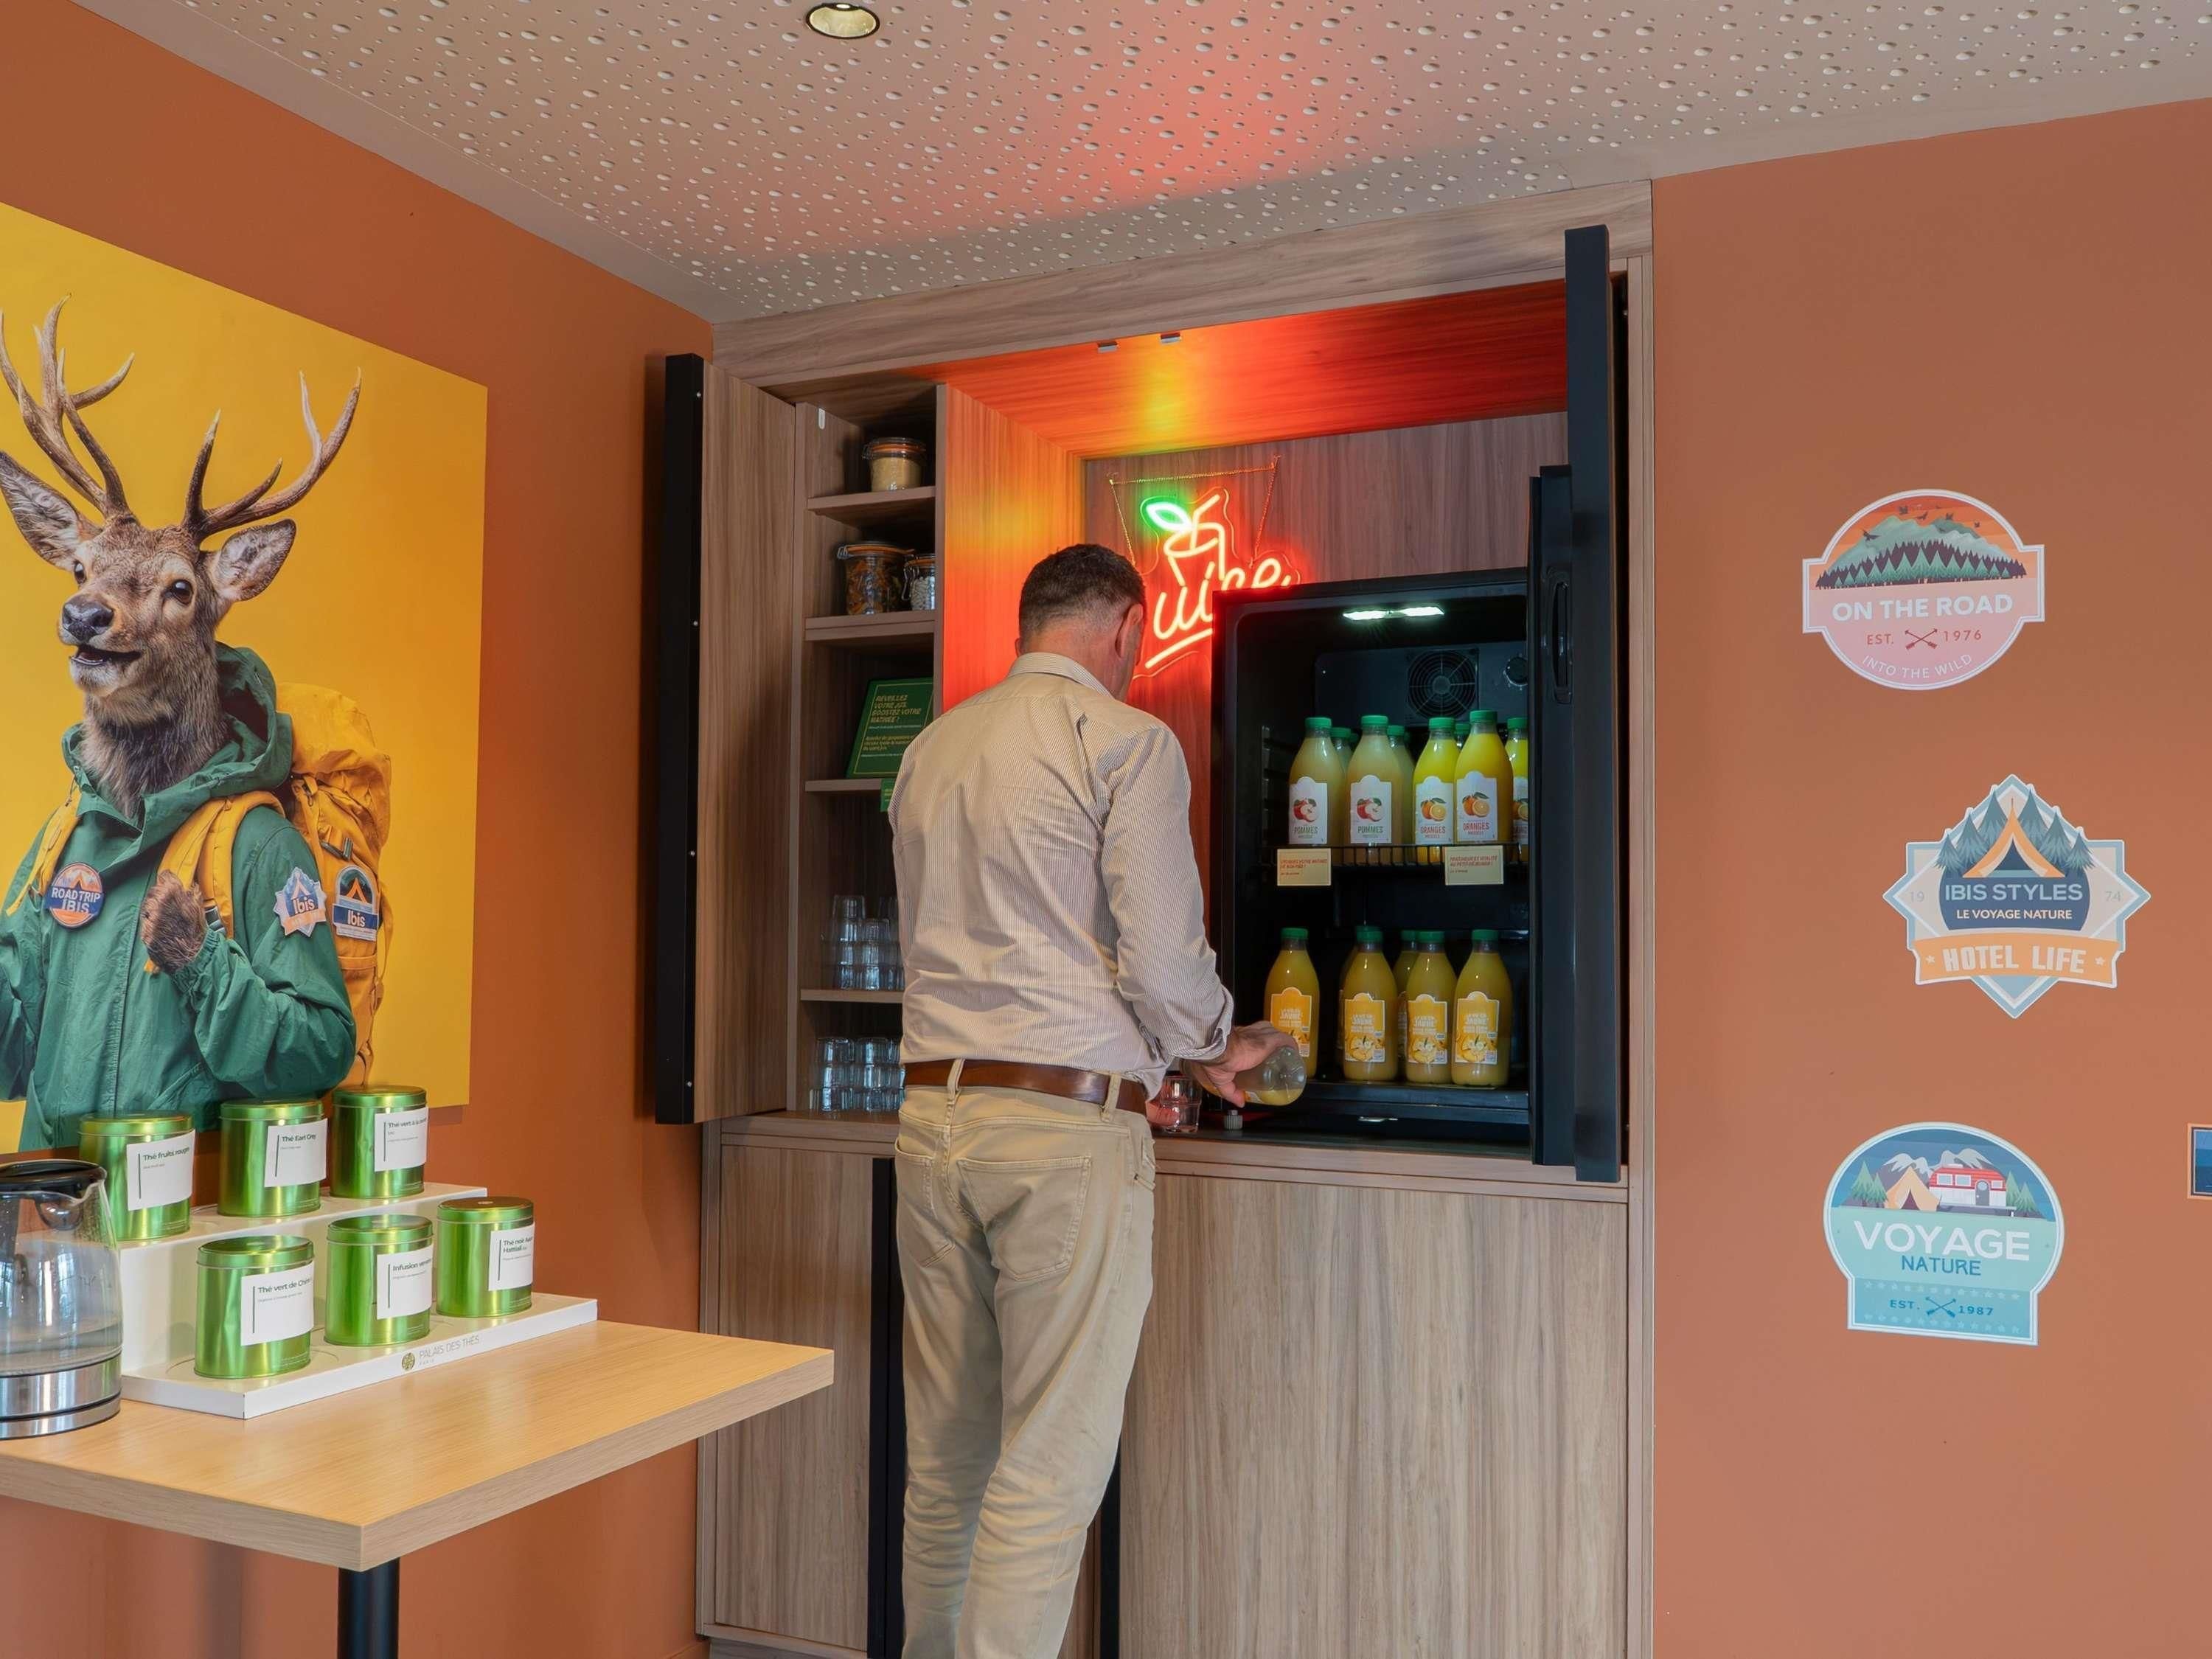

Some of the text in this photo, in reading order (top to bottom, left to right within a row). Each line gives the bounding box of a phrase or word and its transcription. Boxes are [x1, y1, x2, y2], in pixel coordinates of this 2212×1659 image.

[1832, 594, 2013, 622] ON THE ROAD
[1866, 629, 1982, 645] EST. 1976
[1862, 653, 1972, 678] INTO THE WILD
[1294, 826, 1318, 834] POMMES
[1357, 826, 1383, 834] POMMES
[1421, 826, 1446, 834] ORANGES
[1462, 822, 1490, 831] ORANGES
[52, 887, 101, 903] ROAD TRIP
[1910, 891, 1924, 902] 19
[1945, 883, 2083, 901] IBIS STYLES
[2104, 891, 2122, 902] 74
[62, 898, 90, 914] IBIS
[292, 897, 316, 914] Ibis
[347, 909, 366, 928] Ibis
[1956, 909, 2073, 919] LE VOYAGE NATURE
[1942, 945, 2087, 973] HOTEL LIFE
[1854, 1220, 2030, 1261] VOYAGE
[393, 1263, 419, 1271] Infusion
[1901, 1255, 1981, 1276] NATURE
[1890, 1298, 1994, 1316] EST. 1987
[419, 1344, 445, 1357] PALAIS
[445, 1340, 461, 1353] DES
